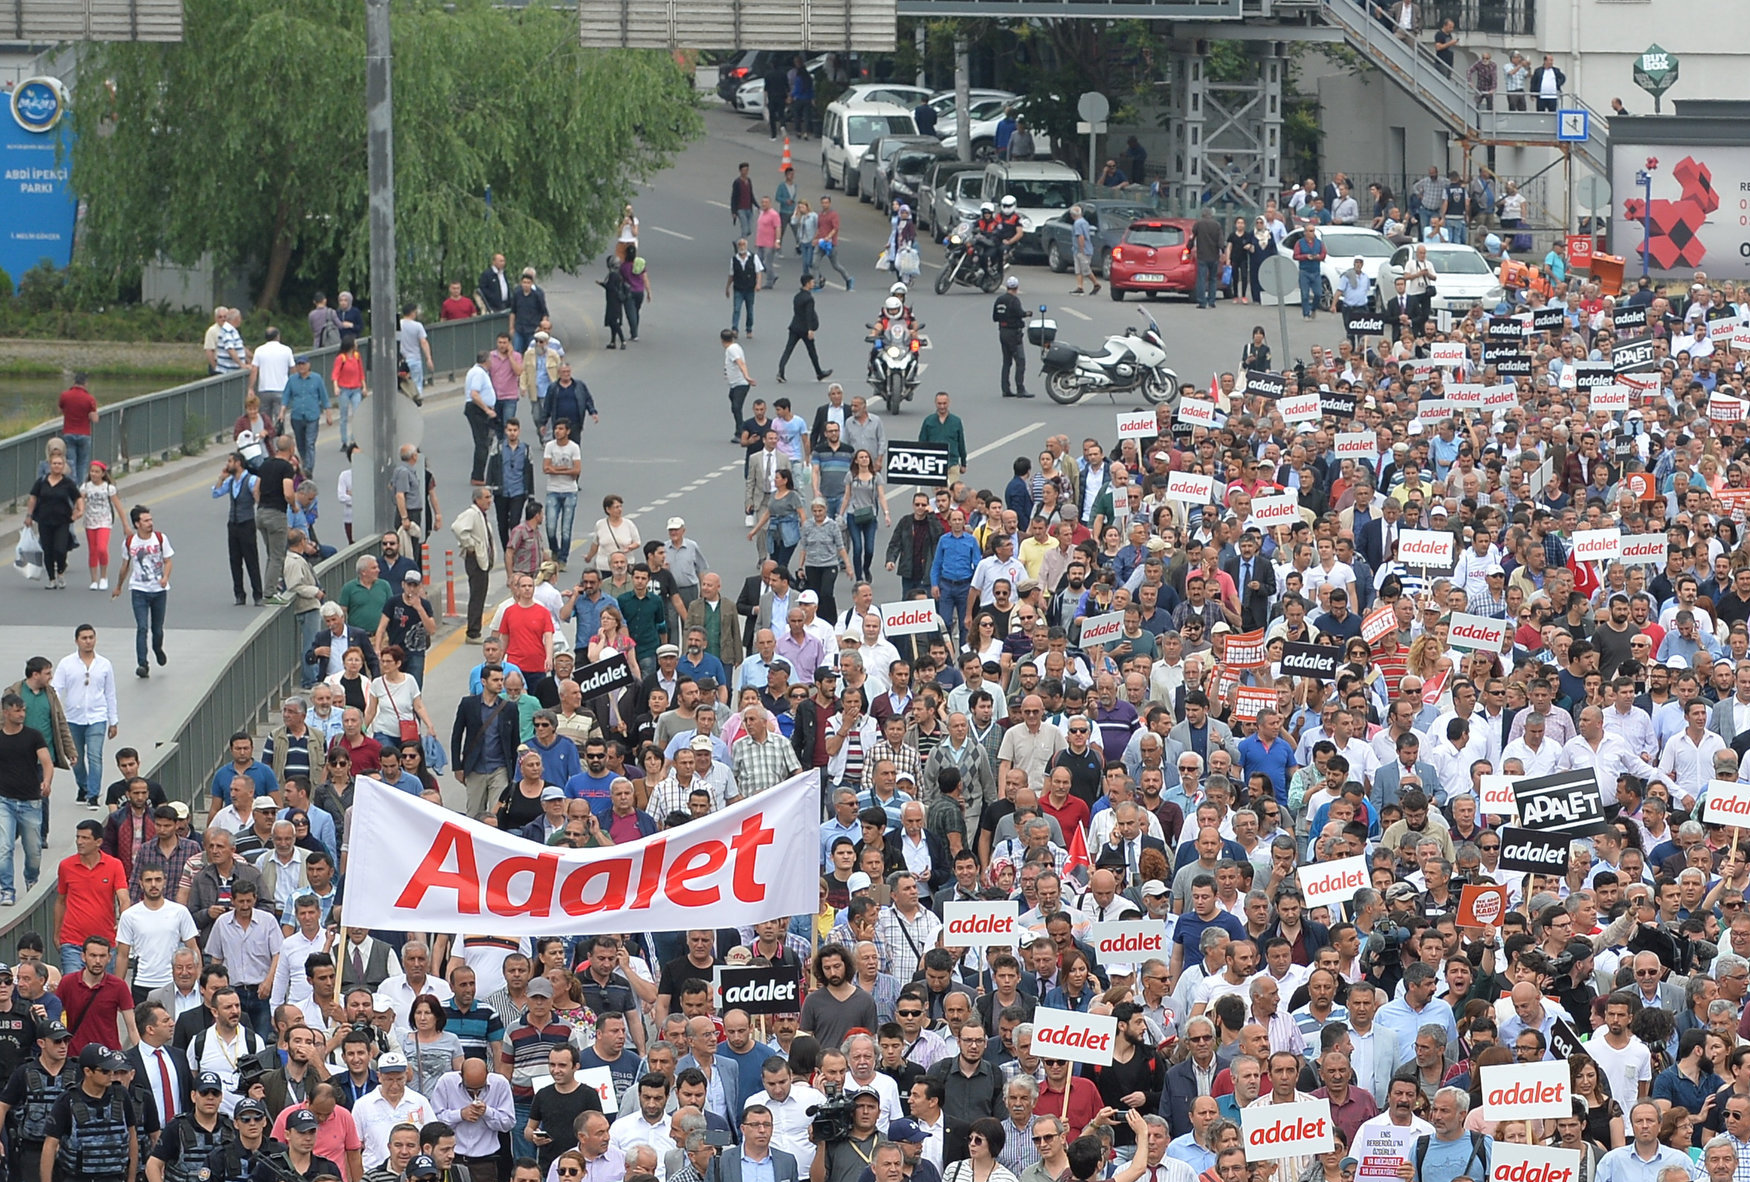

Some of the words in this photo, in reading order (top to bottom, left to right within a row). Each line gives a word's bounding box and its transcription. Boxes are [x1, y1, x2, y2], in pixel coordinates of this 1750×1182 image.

[1643, 53, 1668, 62] BUY
[1643, 60, 1669, 70] BOX
[5, 168, 30, 179] ABDİ
[1740, 200, 1746, 209] 0
[1740, 216, 1746, 226] 0
[1350, 318, 1382, 330] adalet
[1534, 312, 1562, 326] adalet
[1615, 311, 1645, 325] adalet
[1490, 324, 1521, 334] adalet
[1434, 350, 1462, 359] adalet
[1614, 346, 1651, 366] ADALET
[1498, 360, 1530, 372] adalet
[1248, 380, 1283, 395] adalet
[1578, 375, 1613, 386] adalet
[1448, 392, 1481, 401] adalet
[1484, 391, 1514, 404] adalet
[1593, 393, 1626, 404] adalet
[1181, 405, 1210, 419] adalet
[1285, 402, 1318, 415] adalet
[1320, 399, 1354, 412] adalet
[1420, 408, 1451, 418] adalet
[1120, 420, 1153, 432] adalet
[1338, 440, 1373, 451] adalet
[1338, 441, 1374, 451] adalet
[888, 453, 947, 475] ADALET
[1170, 483, 1208, 496] adalet
[1256, 504, 1295, 519] adalet
[1402, 540, 1448, 554] adalet
[1577, 538, 1618, 552] adalet
[1622, 544, 1664, 556] adalet
[887, 611, 932, 626] adalet
[1083, 622, 1120, 638] adalet
[1452, 623, 1500, 642] adalet
[1284, 652, 1334, 671] adalet
[580, 663, 628, 694] adalet
[1523, 790, 1599, 826] ADALET
[1504, 842, 1566, 864] adalet
[394, 812, 775, 917] Adalet
[1307, 870, 1364, 896] adalet
[948, 914, 1013, 934] adalet
[1100, 932, 1162, 953] adalet
[725, 979, 796, 1003] adalet
[1037, 1024, 1109, 1051] adalet
[1488, 1081, 1564, 1105] adalet
[1251, 1117, 1325, 1145] adalet
